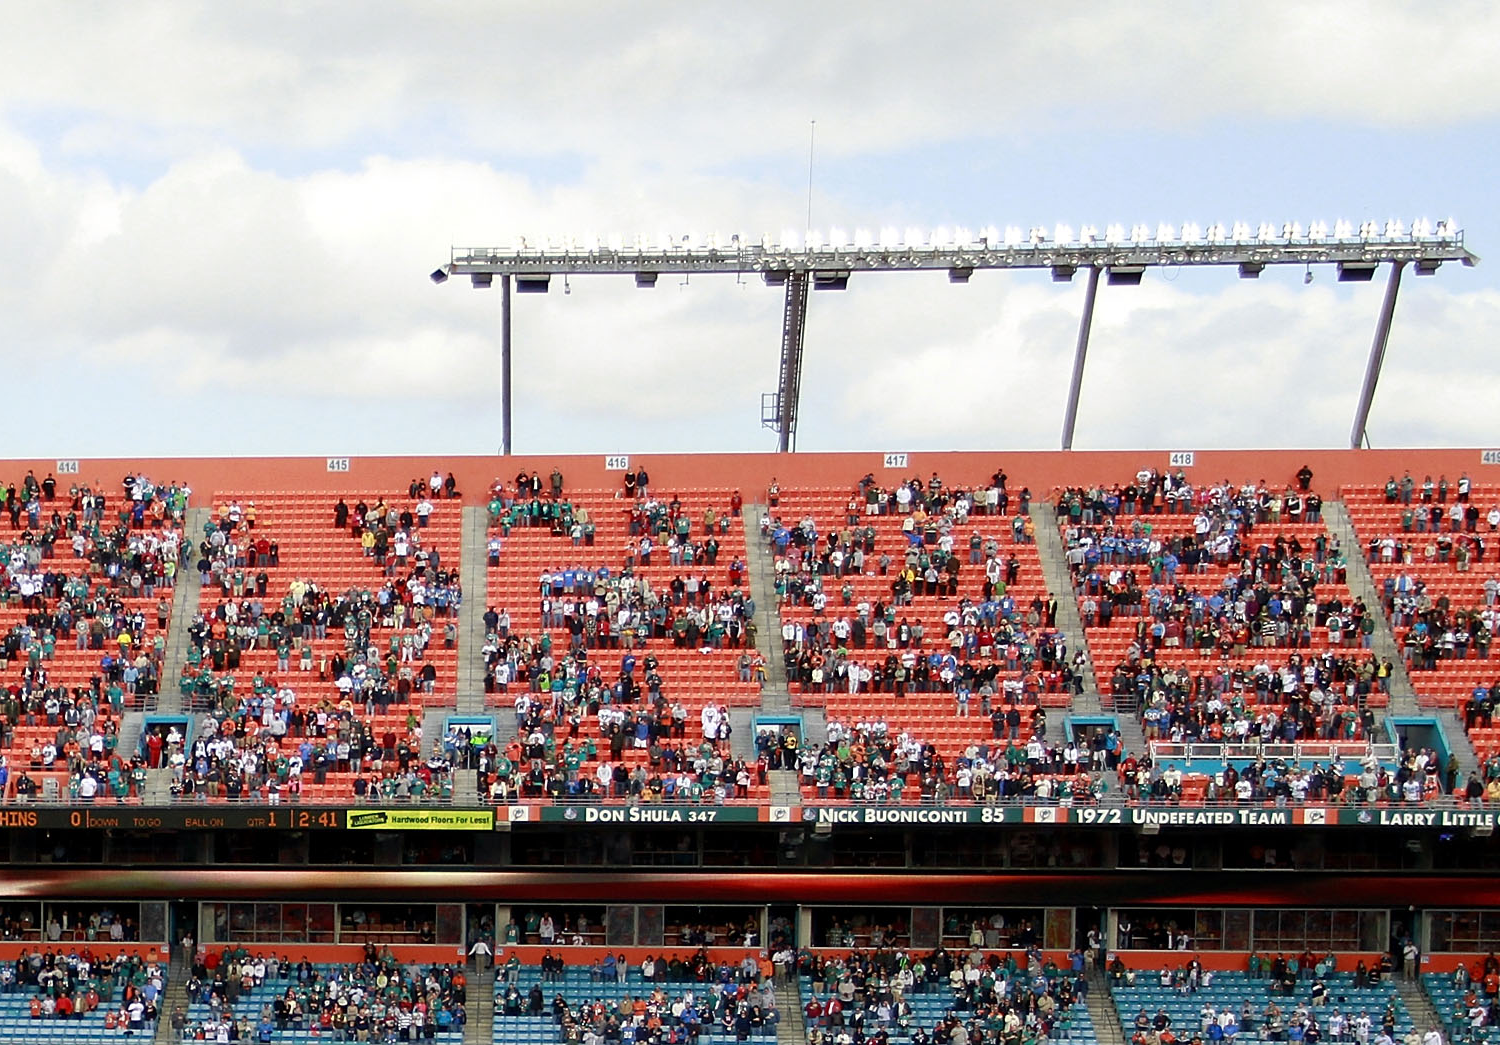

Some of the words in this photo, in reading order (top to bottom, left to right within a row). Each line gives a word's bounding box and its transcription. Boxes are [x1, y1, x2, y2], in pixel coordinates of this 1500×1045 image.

[329, 460, 347, 470] 415
[608, 457, 626, 467] 416
[886, 455, 905, 465] 417
[1172, 454, 1191, 464] 418
[59, 462, 77, 472] 414
[70, 811, 81, 827] 0
[268, 811, 277, 827] 1
[299, 811, 338, 828] 2:41
[391, 816, 429, 824] Hardwood
[430, 816, 453, 824] Floors
[455, 816, 468, 824] For
[469, 816, 490, 824] Less!
[585, 807, 624, 821] DON
[629, 807, 682, 822] SHULA
[688, 811, 716, 822] 347
[819, 808, 859, 822] NICK
[864, 808, 967, 823] BUONICONTI
[981, 808, 1004, 823] 85
[1076, 809, 1121, 824] 1972
[1132, 809, 1234, 825] UNDEFEATED
[1238, 810, 1286, 825] TEAM
[1380, 810, 1436, 825] LARRY
[1442, 811, 1494, 826] LITTLE
[90, 817, 119, 827] DOWN
